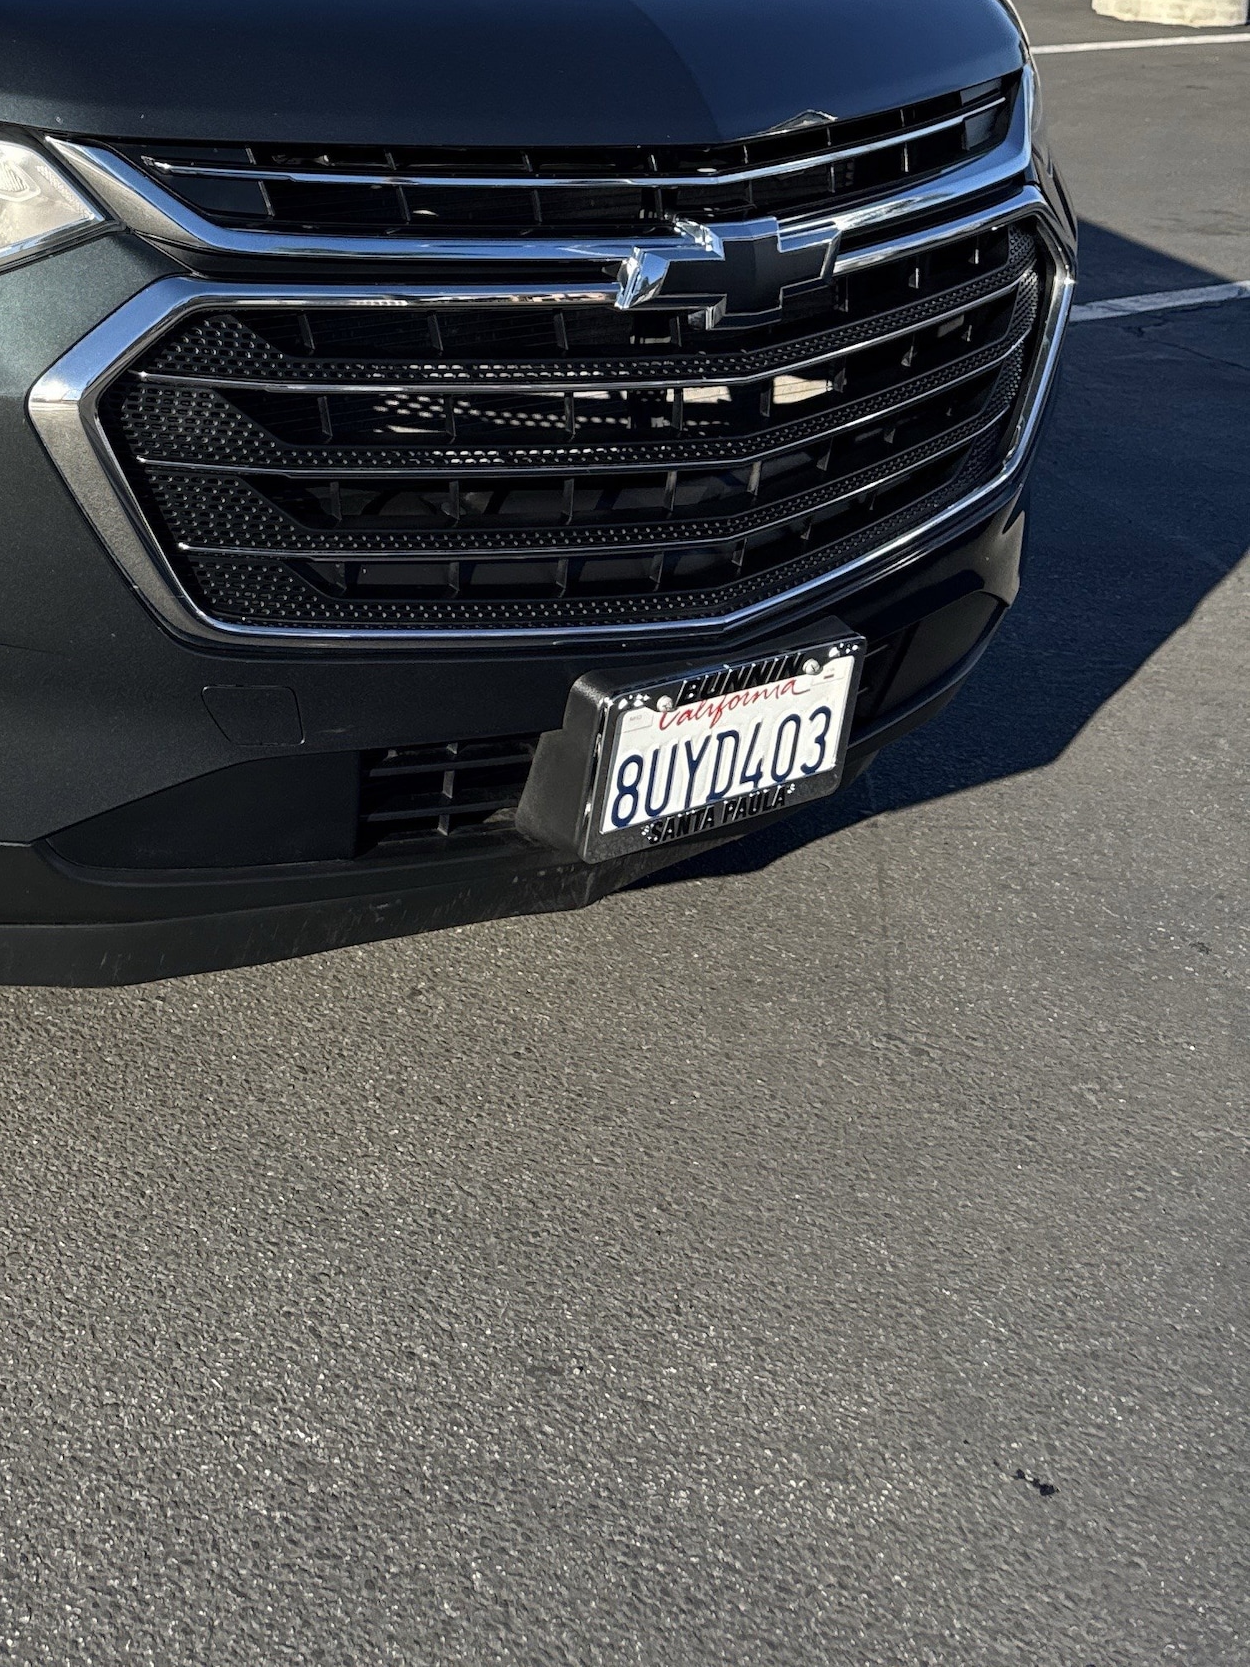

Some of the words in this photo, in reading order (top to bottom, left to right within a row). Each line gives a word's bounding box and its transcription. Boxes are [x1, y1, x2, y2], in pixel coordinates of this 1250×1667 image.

[658, 678, 811, 731] California
[675, 652, 804, 707] BUNNIN
[610, 705, 833, 828] 8UYD403
[649, 803, 716, 845] SANTA
[721, 785, 786, 825] PAULA
